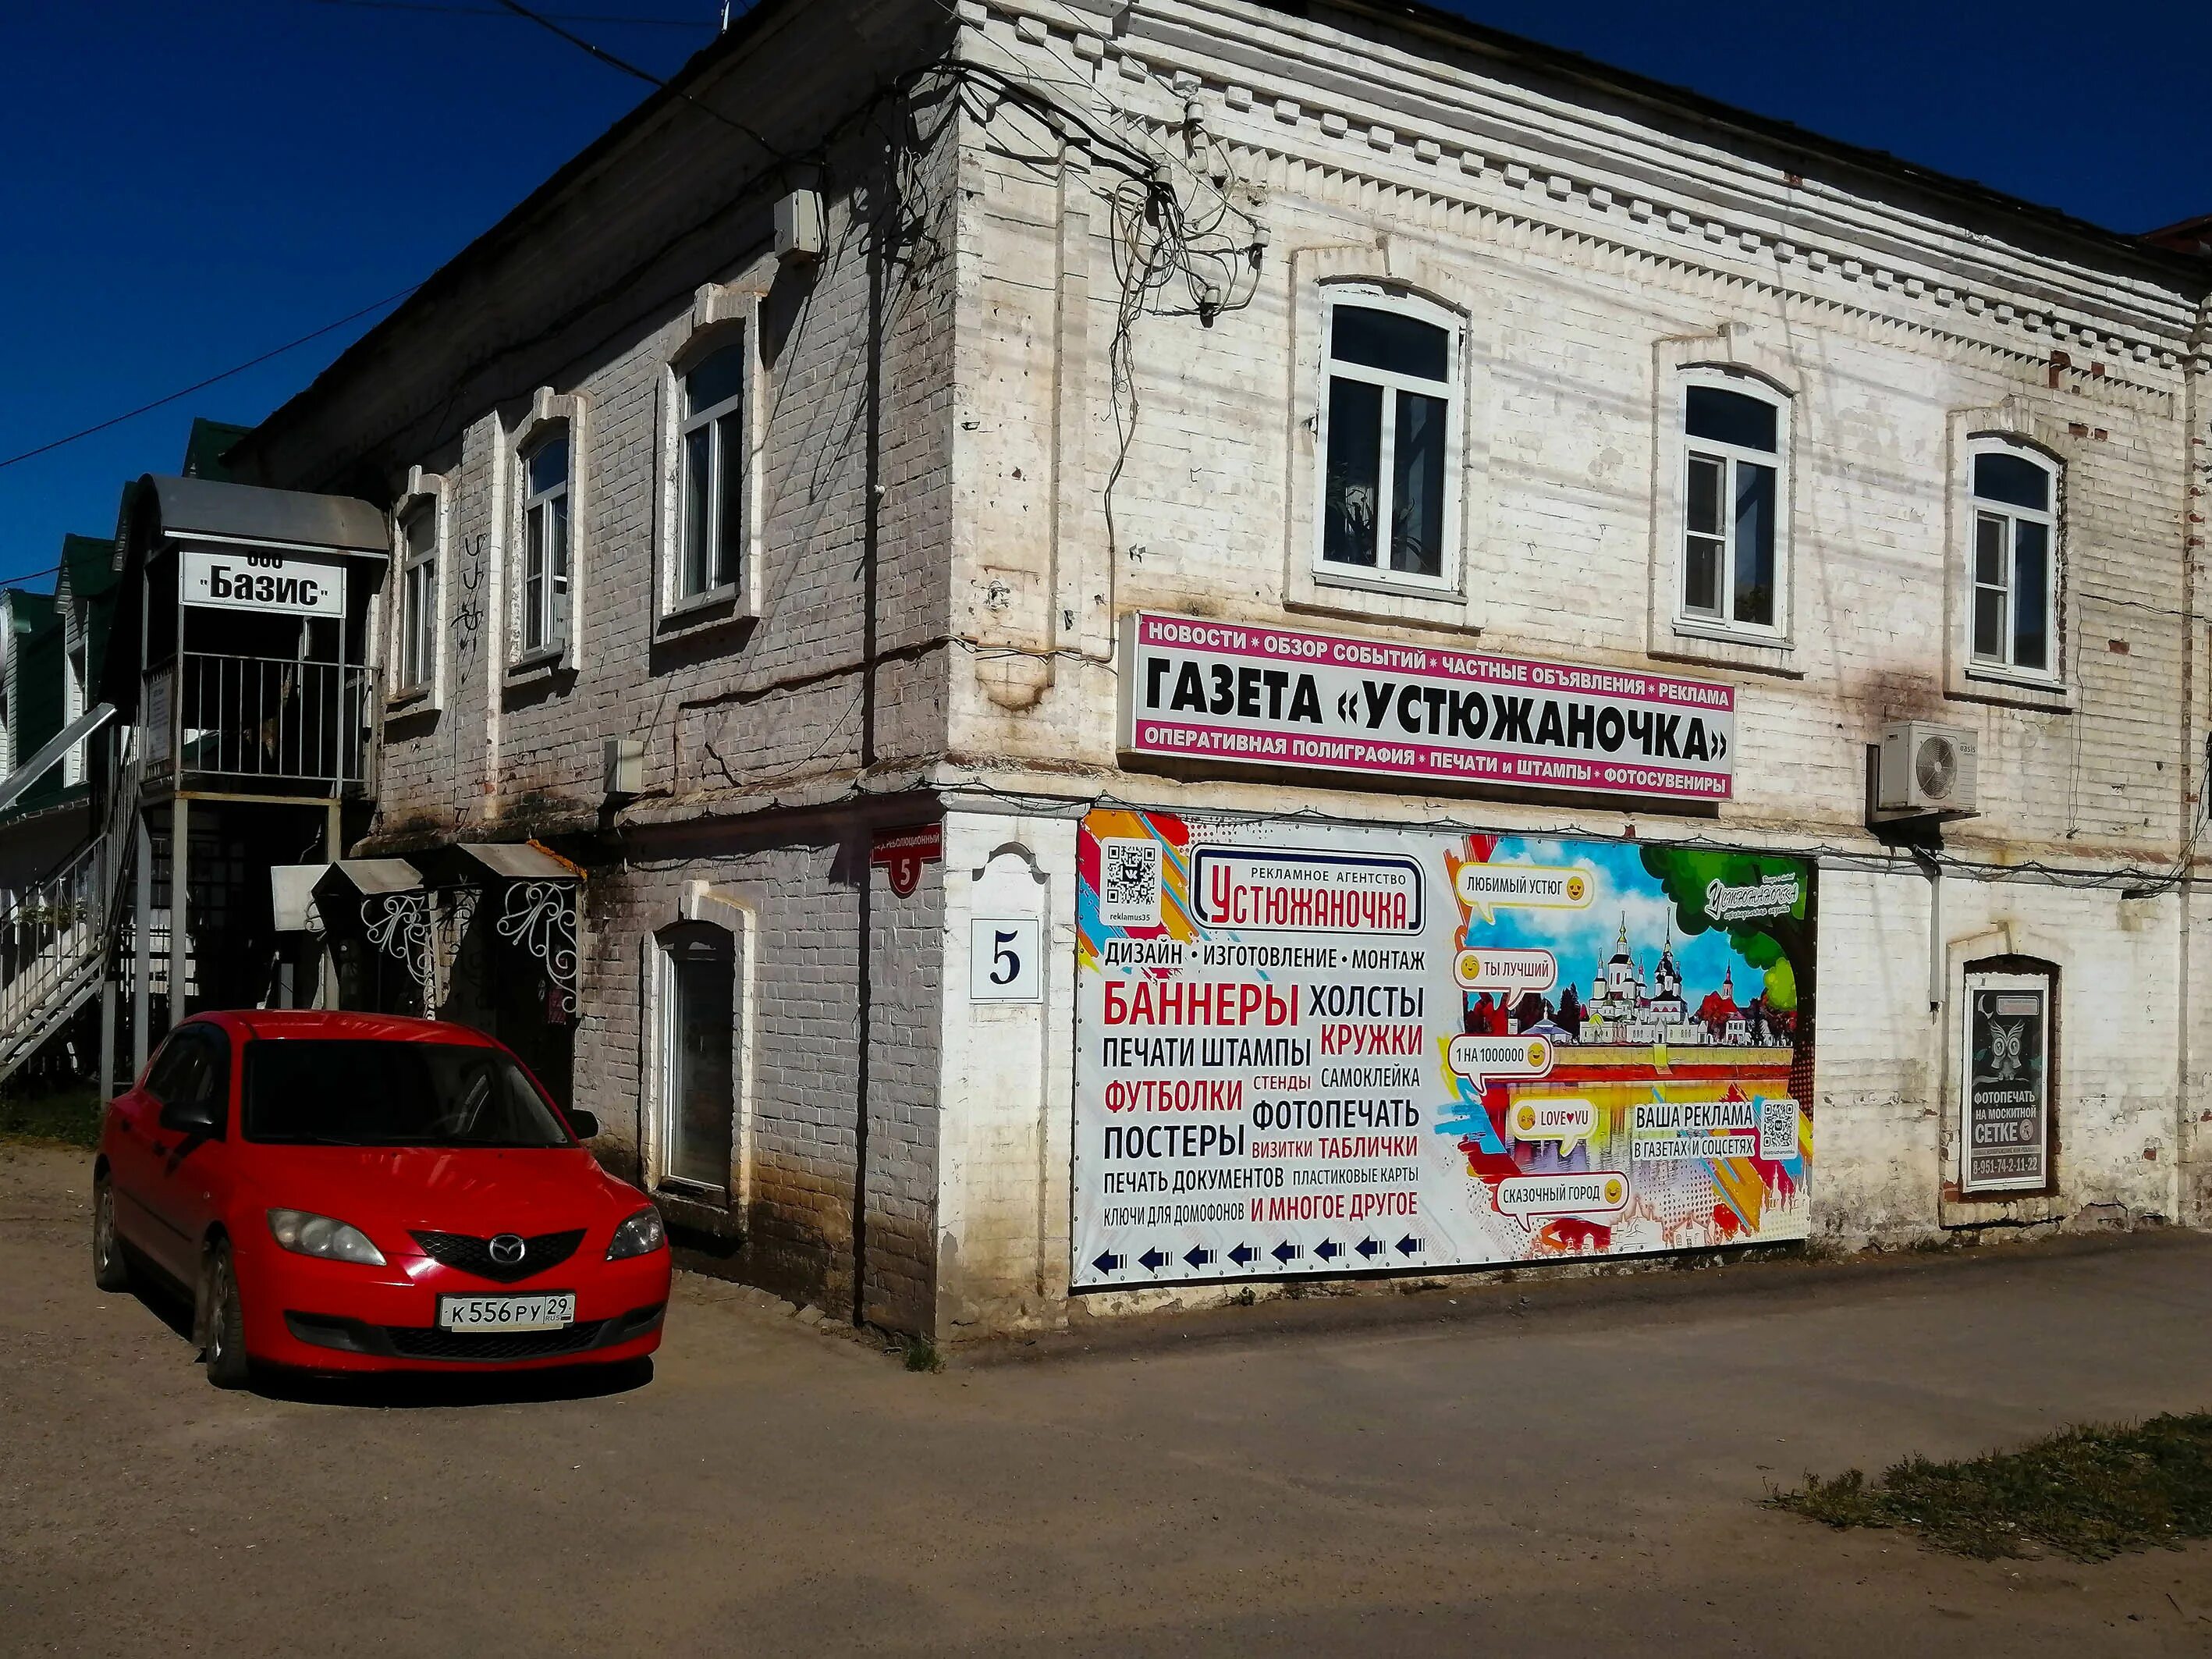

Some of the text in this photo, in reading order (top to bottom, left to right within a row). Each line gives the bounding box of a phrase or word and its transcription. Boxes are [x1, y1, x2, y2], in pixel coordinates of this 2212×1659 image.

[247, 551, 282, 569] ООО
[1149, 621, 1728, 705] НОВОСТИ ОБЗОР СОБЫТИЙ ЧАСТНЫЕ ОБЪЯВЛЕНИЯ РЕКЛАМА
[1147, 658, 1727, 762] ГАЗЕТА «УСТЮЖАНОЧКА»
[1145, 726, 1286, 755] ОПЕРАТИВНАЯ
[1292, 740, 1414, 766] ПОЛИГРАФИЯ
[1430, 752, 1497, 773] ПЕЧАТИ
[1517, 760, 1591, 780] ШТАМПЫ
[1604, 767, 1725, 794] ФОТОСУВЕНИРЫ
[900, 859, 910, 885] 5
[1251, 867, 1406, 884] РЕКЛАМНОЕ АГЕНТСТВО
[1467, 876, 1562, 895] ЛЮБИМЫЙ УСТЮГ
[1110, 912, 1150, 922] reklamus35
[989, 929, 1021, 984] 5
[1105, 940, 1425, 970] ДИЗАЙН ИЗГОТОВЛЕНИЕ МОНТАЖ
[1485, 959, 1548, 978] ТЫ ЛУЧШИЙ
[1105, 982, 1298, 1025] БАННЕРЫ
[1308, 986, 1423, 1017] ХОЛСТЫ
[1321, 1025, 1422, 1055] КРУЖКИ
[1103, 1038, 1311, 1068] ПЕЧАТИ ШТАМПЫ
[1457, 1046, 1524, 1063] 1 НА 1000000
[1254, 1075, 1311, 1091] СТЕНДЫ
[1321, 1064, 1419, 1088] САМОКЛЕЙКА
[1105, 1080, 1242, 1113] ФУТБОЛКИ
[1975, 1091, 2035, 1104] ФОТОПЕЧАТЬ
[1252, 1099, 1418, 1131] ФОТОПЕЧАТЬ
[1636, 1103, 1752, 1128] ВАША РЕКЛАМА
[1976, 1105, 2036, 1120] НА МОСКИТНОЙ
[1104, 1124, 1244, 1159] ПОСТЕРЫ
[1976, 1122, 2018, 1143] СЕТКЕ
[1252, 1142, 1312, 1158] ВИЗИТКИ
[1319, 1136, 1417, 1159] ТАБЛИЧКИ
[1635, 1138, 1754, 1157] В ГАЗЕТАХ И СОЦСЕТЯХ
[1104, 1167, 1284, 1194] ПЕЧАТЬ ДОКУМЕНТОВ
[1293, 1167, 1418, 1185] ПЛАСТИКОВЫЕ КАРТЫ
[1503, 1184, 1600, 1204] СКАЗОЧНЫЙ ГОРОД
[1104, 1203, 1244, 1227] КЛЮЧИ ДЛЯ ДОМОФОНОВ
[1251, 1192, 1417, 1222] И МНОГОЕ ДРУГОЕ
[548, 1298, 567, 1315] 29
